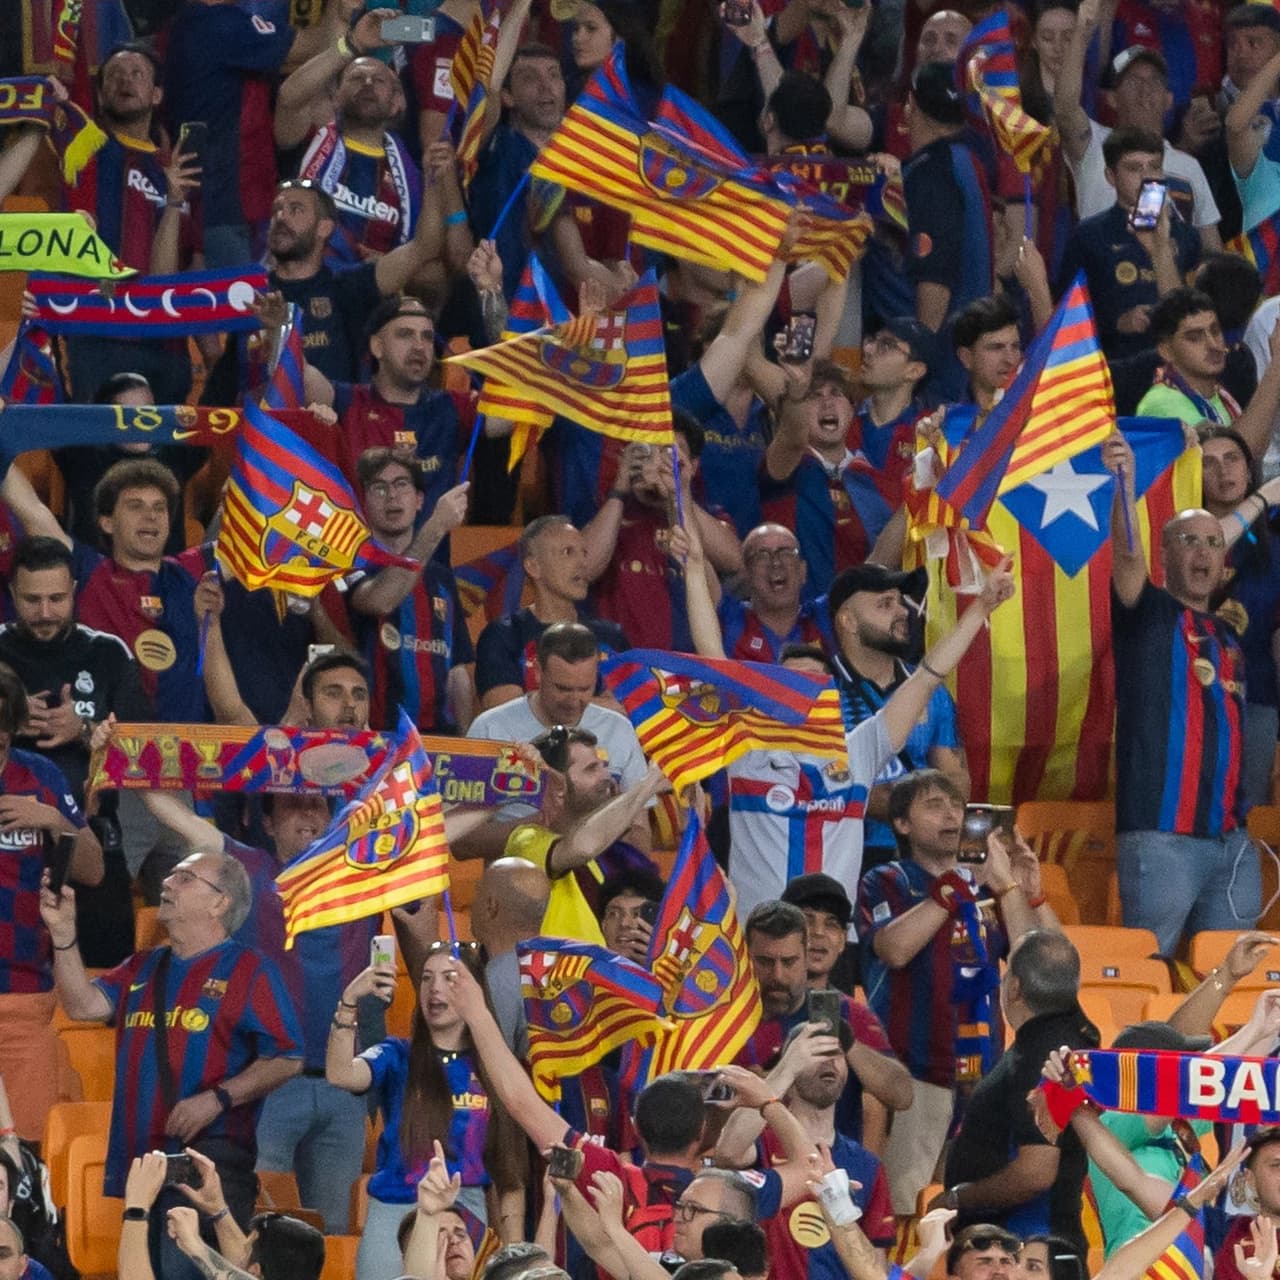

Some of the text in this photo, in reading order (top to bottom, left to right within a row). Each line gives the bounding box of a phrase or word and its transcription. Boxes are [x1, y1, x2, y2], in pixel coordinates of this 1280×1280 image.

[296, 530, 330, 558] FCB
[403, 634, 451, 660] Spotify
[1187, 1056, 1280, 1113] BA
